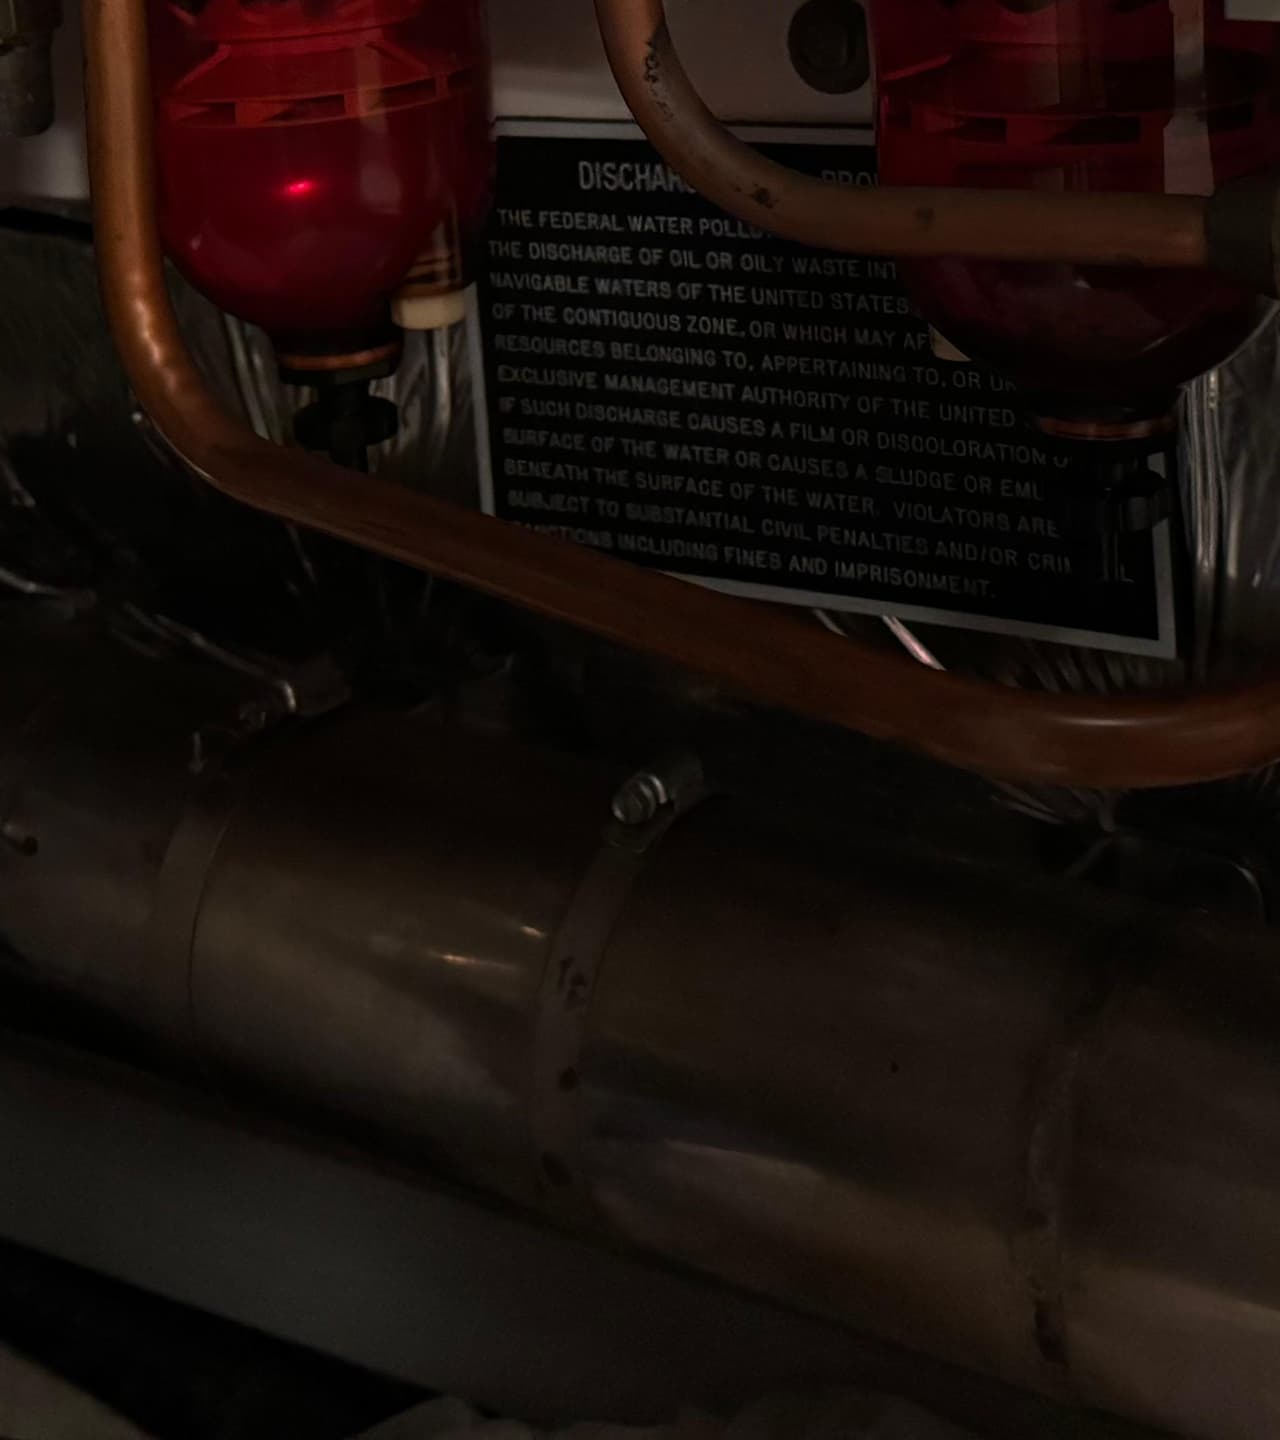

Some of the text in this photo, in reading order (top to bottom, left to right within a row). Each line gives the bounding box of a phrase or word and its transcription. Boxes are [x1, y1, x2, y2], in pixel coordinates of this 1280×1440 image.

[497, 209, 531, 227] THE
[539, 211, 623, 232] FEDERAL
[627, 215, 693, 236] WATER
[488, 240, 521, 258] THE
[528, 242, 633, 265] DISCHARGE
[639, 248, 663, 266] OF
[670, 250, 702, 269] OIL
[706, 251, 733, 270] OR
[740, 253, 784, 273] OILY
[792, 257, 860, 278] WASTE
[490, 272, 589, 294] NAVIGABLE
[595, 277, 670, 299] WATERS
[677, 281, 703, 300] OF
[708, 283, 745, 304] THE
[751, 287, 824, 309] UNITED
[492, 303, 515, 320] OF
[523, 305, 557, 323] THE
[563, 308, 681, 332] CONTIGUOUS
[750, 320, 776, 339] OR
[783, 323, 847, 344] WHICH
[854, 327, 896, 349] MAY
[495, 334, 605, 356] RESOURCES
[611, 340, 716, 367] BELONGING
[762, 355, 905, 384] APPERTAINING
[953, 371, 981, 390] OR
[497, 364, 1016, 427] EXCLUSIVE MANAGEMENT AUTHORITY OF THE UNITED
[499, 396, 516, 412] IF
[521, 398, 569, 418] SUCH
[575, 403, 681, 429] DISCHARGE
[687, 412, 766, 437] CAUSES
[771, 420, 784, 438] A
[791, 422, 834, 443] FILM
[841, 426, 870, 447] OR
[877, 431, 1046, 465] DISCOLORATION
[503, 426, 585, 451] SURFACE
[591, 435, 615, 453] OF
[622, 437, 656, 458] THE
[664, 442, 729, 466] WATER
[735, 450, 761, 469] OR
[767, 453, 848, 478] CAUSES
[855, 462, 868, 480] A
[875, 464, 957, 491] SLUDGE
[964, 474, 991, 494] OR
[504, 459, 588, 481] BENEATH
[594, 466, 630, 487] THE
[636, 472, 723, 498] SURFACE
[729, 482, 753, 500] OF
[761, 485, 799, 506] THE
[893, 501, 1010, 531] VIOLATORS
[1017, 514, 1061, 539] ARE
[508, 490, 589, 513] SUBJECT
[595, 497, 619, 516] TO
[625, 501, 754, 533] SUBSTANTIAL
[761, 520, 811, 541] CIVIL
[817, 524, 928, 555] PENALTIES
[934, 541, 1018, 567] AND/OR
[618, 534, 718, 561] INCLUDING
[724, 545, 781, 570] FINES
[789, 555, 828, 576] AND
[834, 560, 997, 599] IMPRISONMENT.
